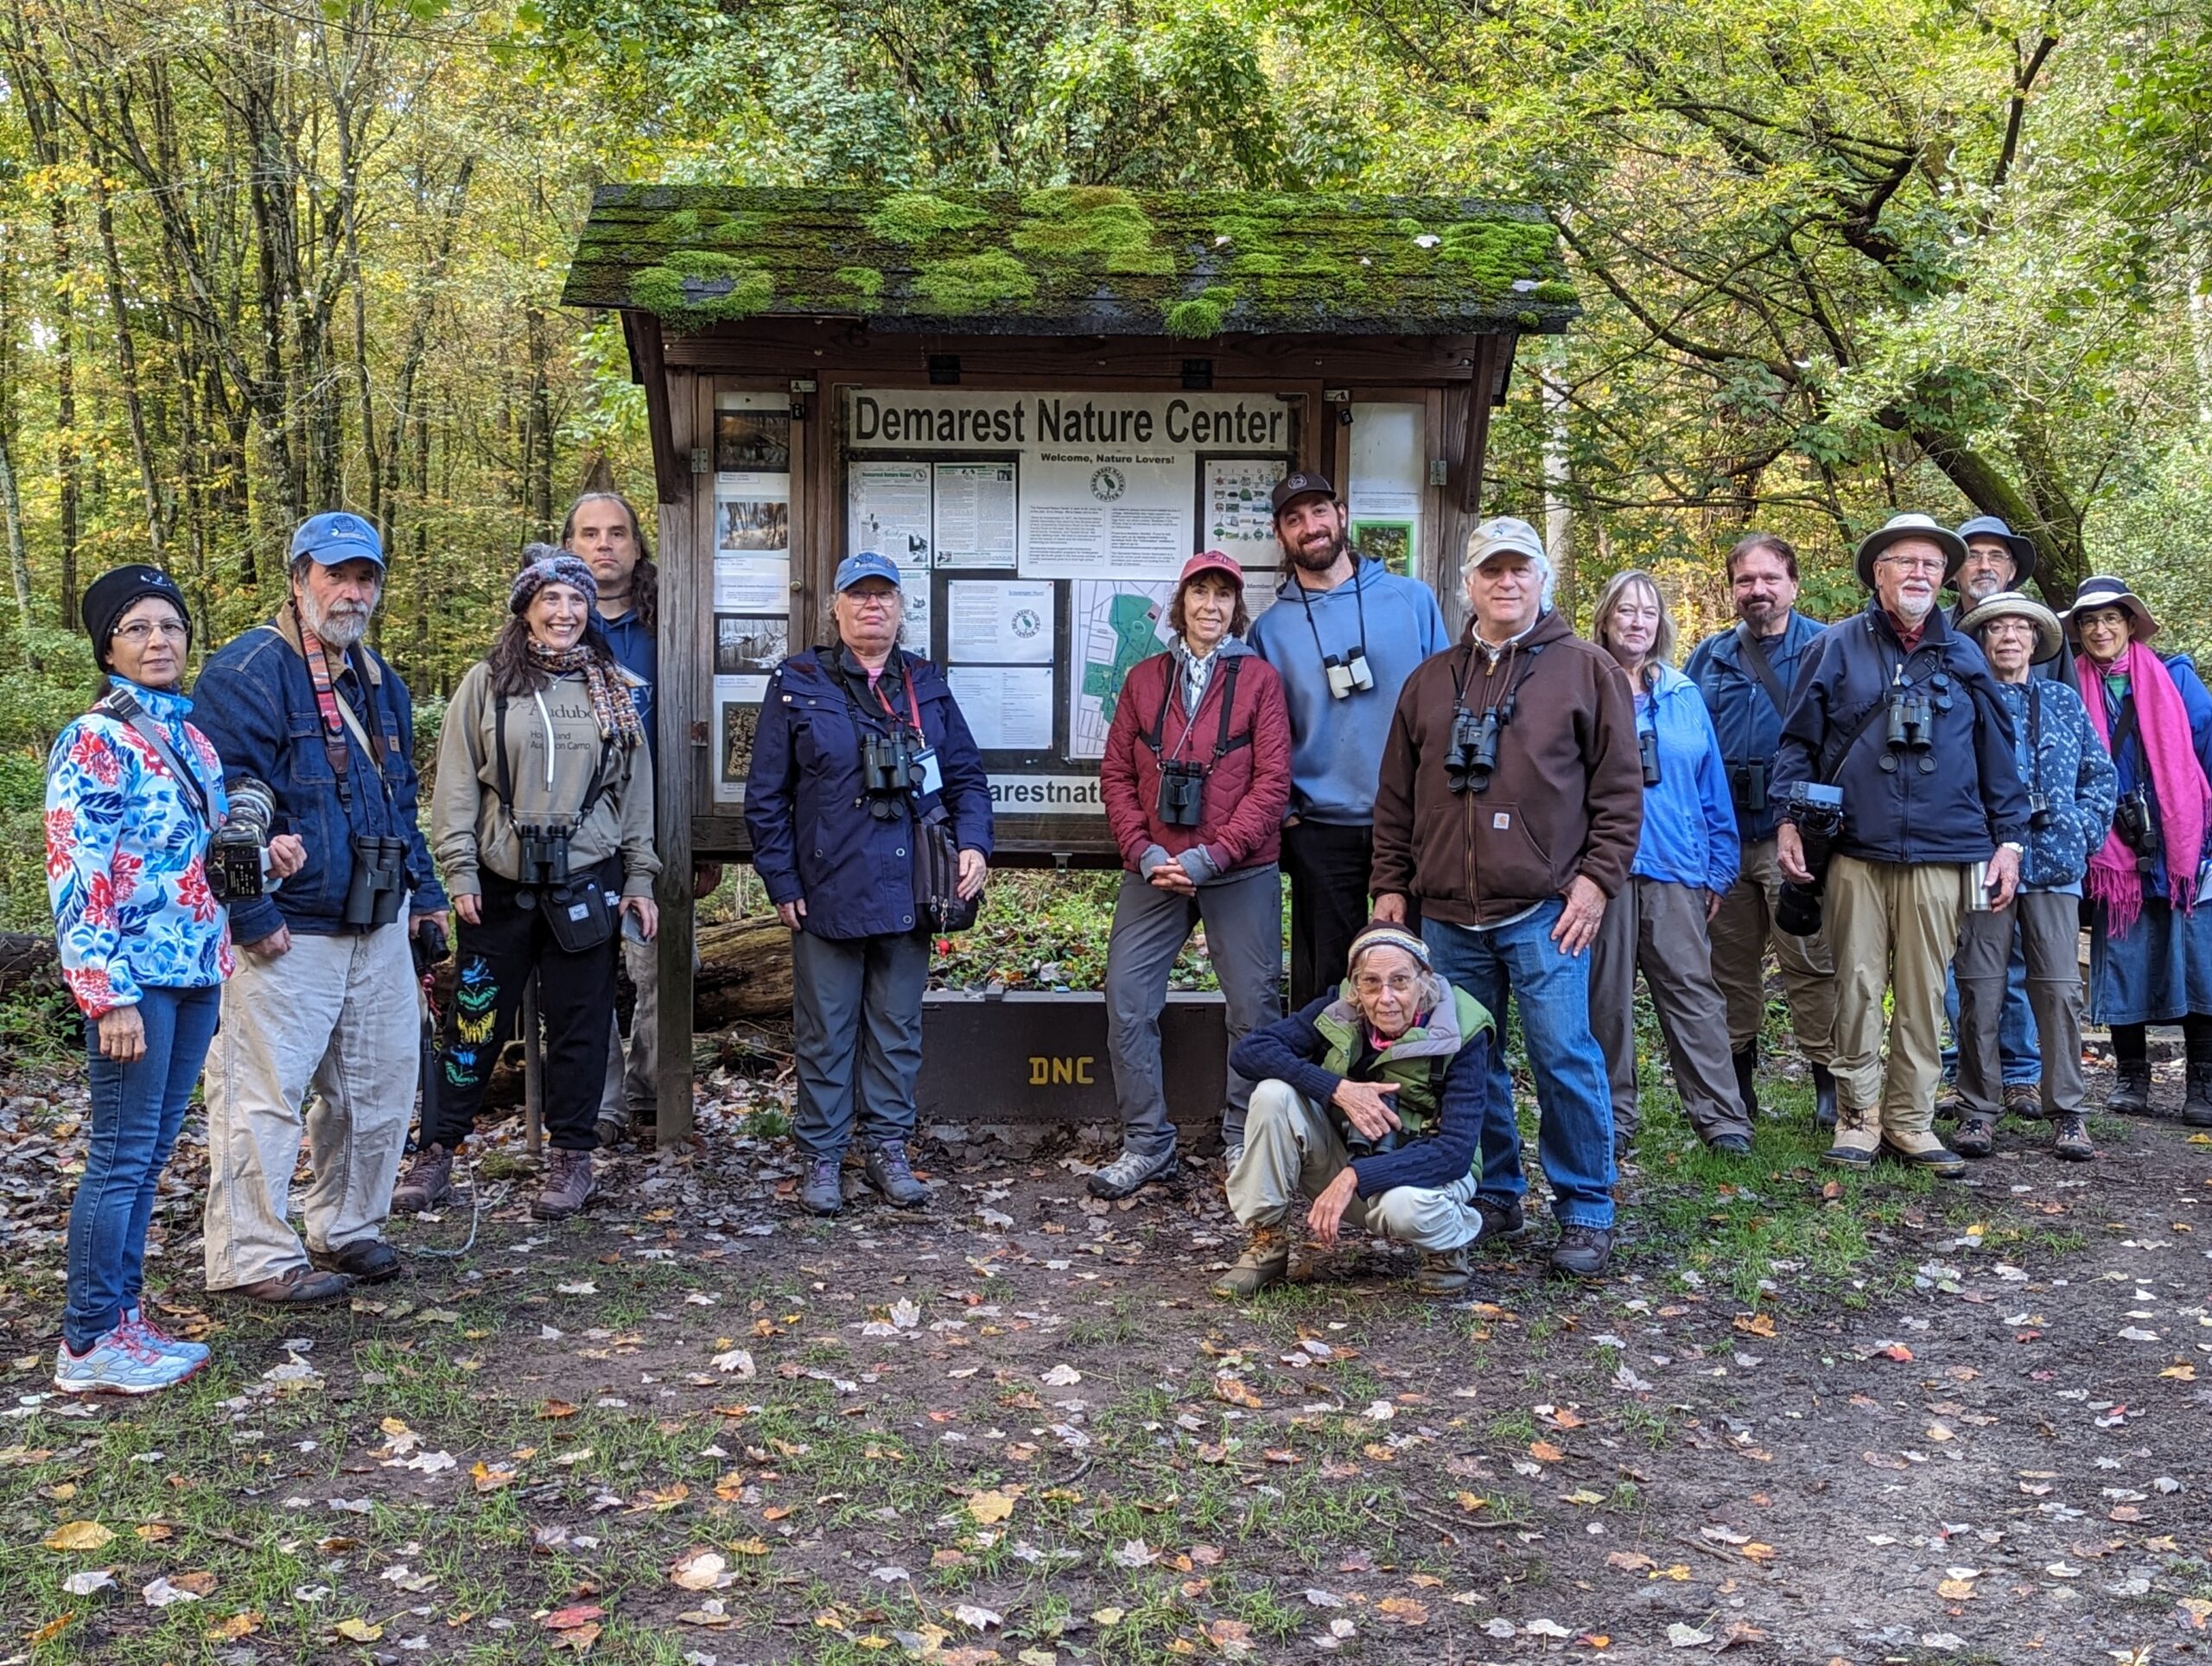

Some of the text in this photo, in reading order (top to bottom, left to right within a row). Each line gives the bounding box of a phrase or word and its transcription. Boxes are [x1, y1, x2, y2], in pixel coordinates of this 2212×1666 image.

[855, 397, 1283, 443] Demarest Nature Center
[1040, 452, 1175, 464] Welcome, Nature Lovers!
[531, 741, 591, 751] Auon Camp
[1028, 1056, 1095, 1084] DNC
